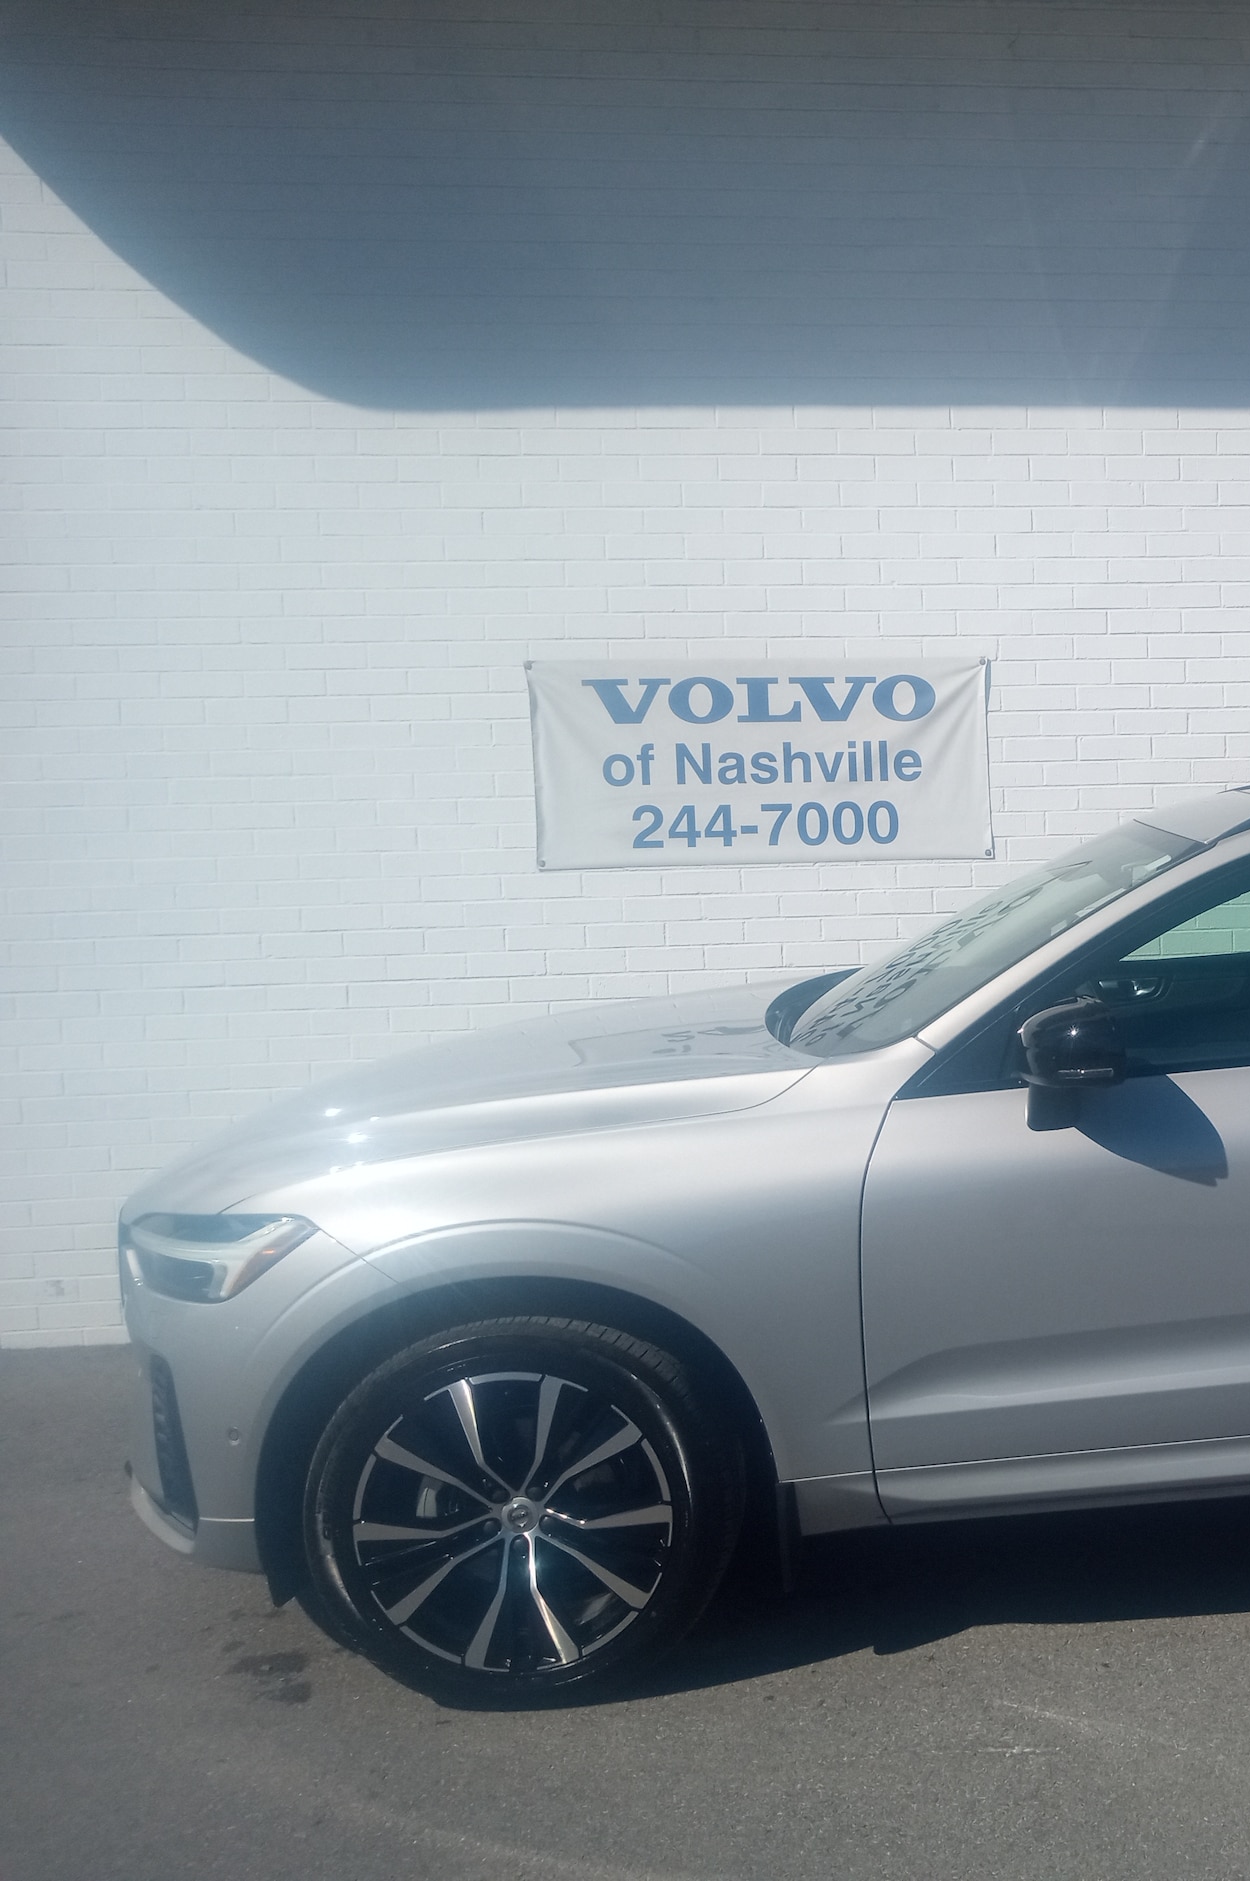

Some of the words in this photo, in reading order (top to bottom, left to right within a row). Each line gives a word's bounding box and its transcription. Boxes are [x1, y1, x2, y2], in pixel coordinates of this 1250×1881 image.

[582, 673, 936, 725] VOLVO
[602, 743, 656, 787] of
[675, 739, 923, 785] Nashville
[632, 800, 900, 849] 244-7000
